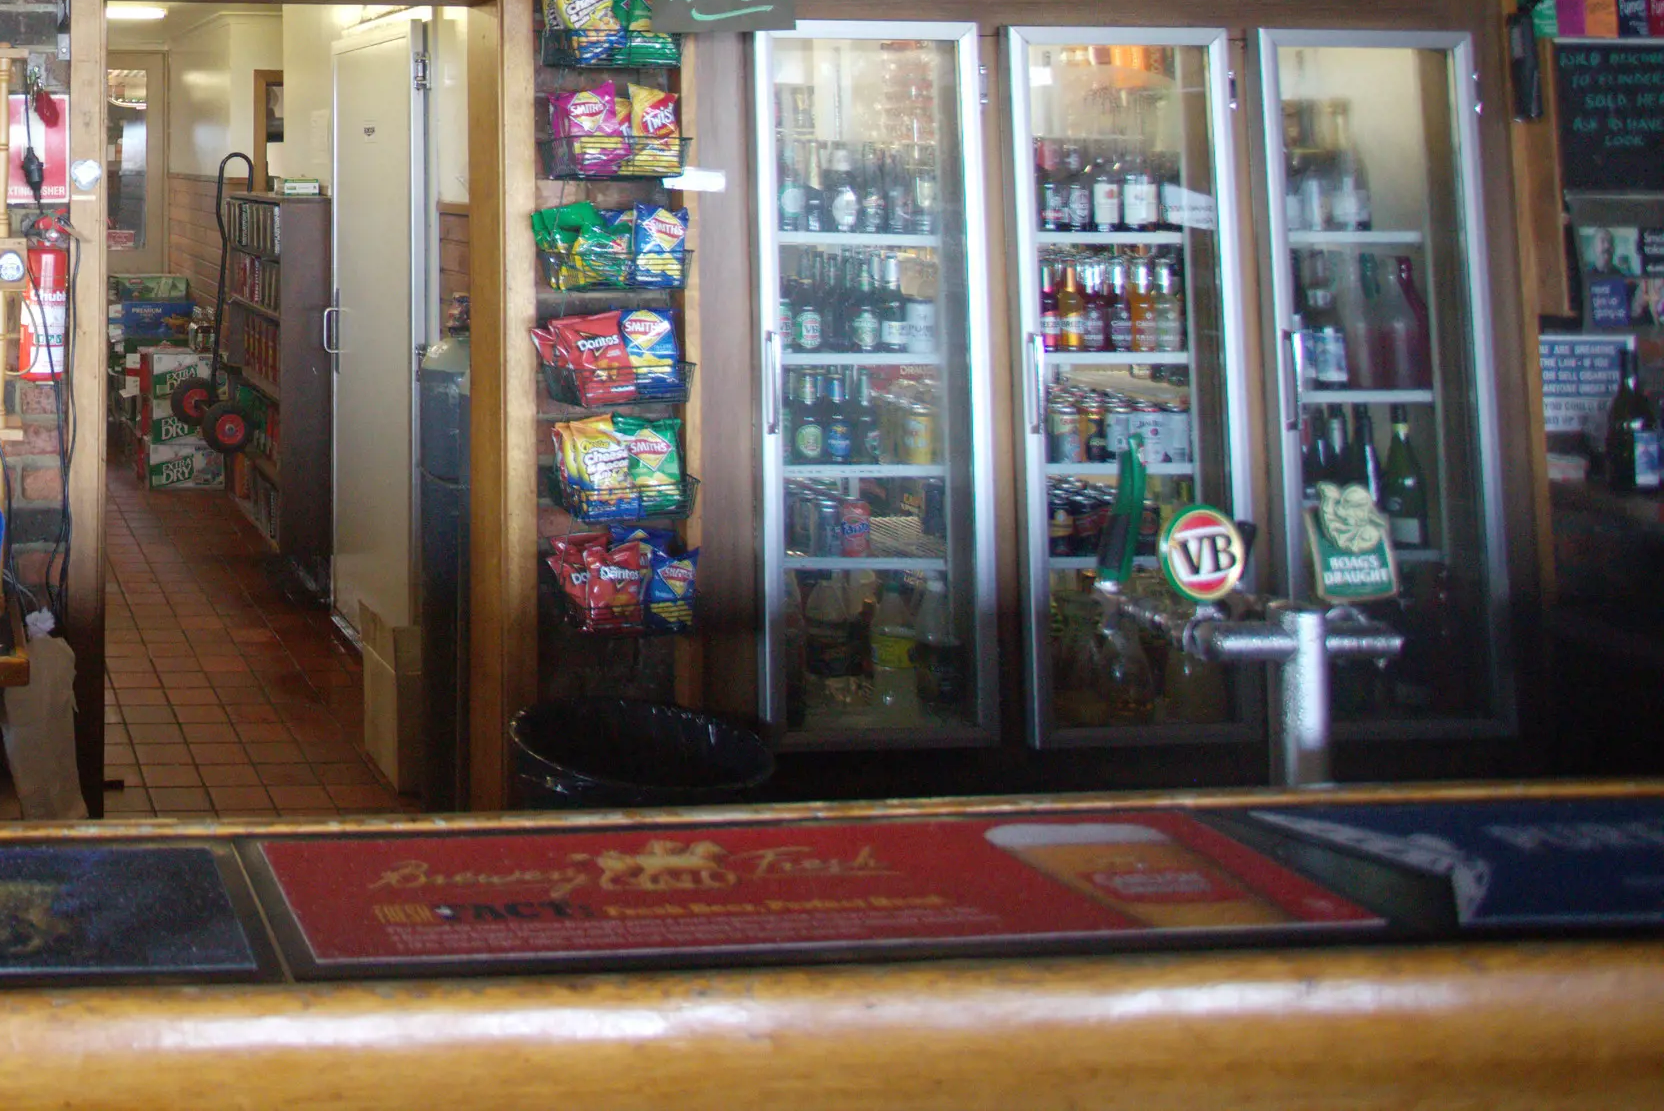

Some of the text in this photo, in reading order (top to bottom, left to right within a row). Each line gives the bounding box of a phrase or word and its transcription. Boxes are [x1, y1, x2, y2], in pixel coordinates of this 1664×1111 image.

[577, 334, 620, 351] Doritos
[166, 364, 198, 382] EXTRA
[161, 424, 190, 440] DRY
[162, 458, 192, 473] EXTRA
[162, 467, 192, 484] DRY
[1172, 533, 1238, 575] VB
[1323, 568, 1389, 586] DRAUGHT
